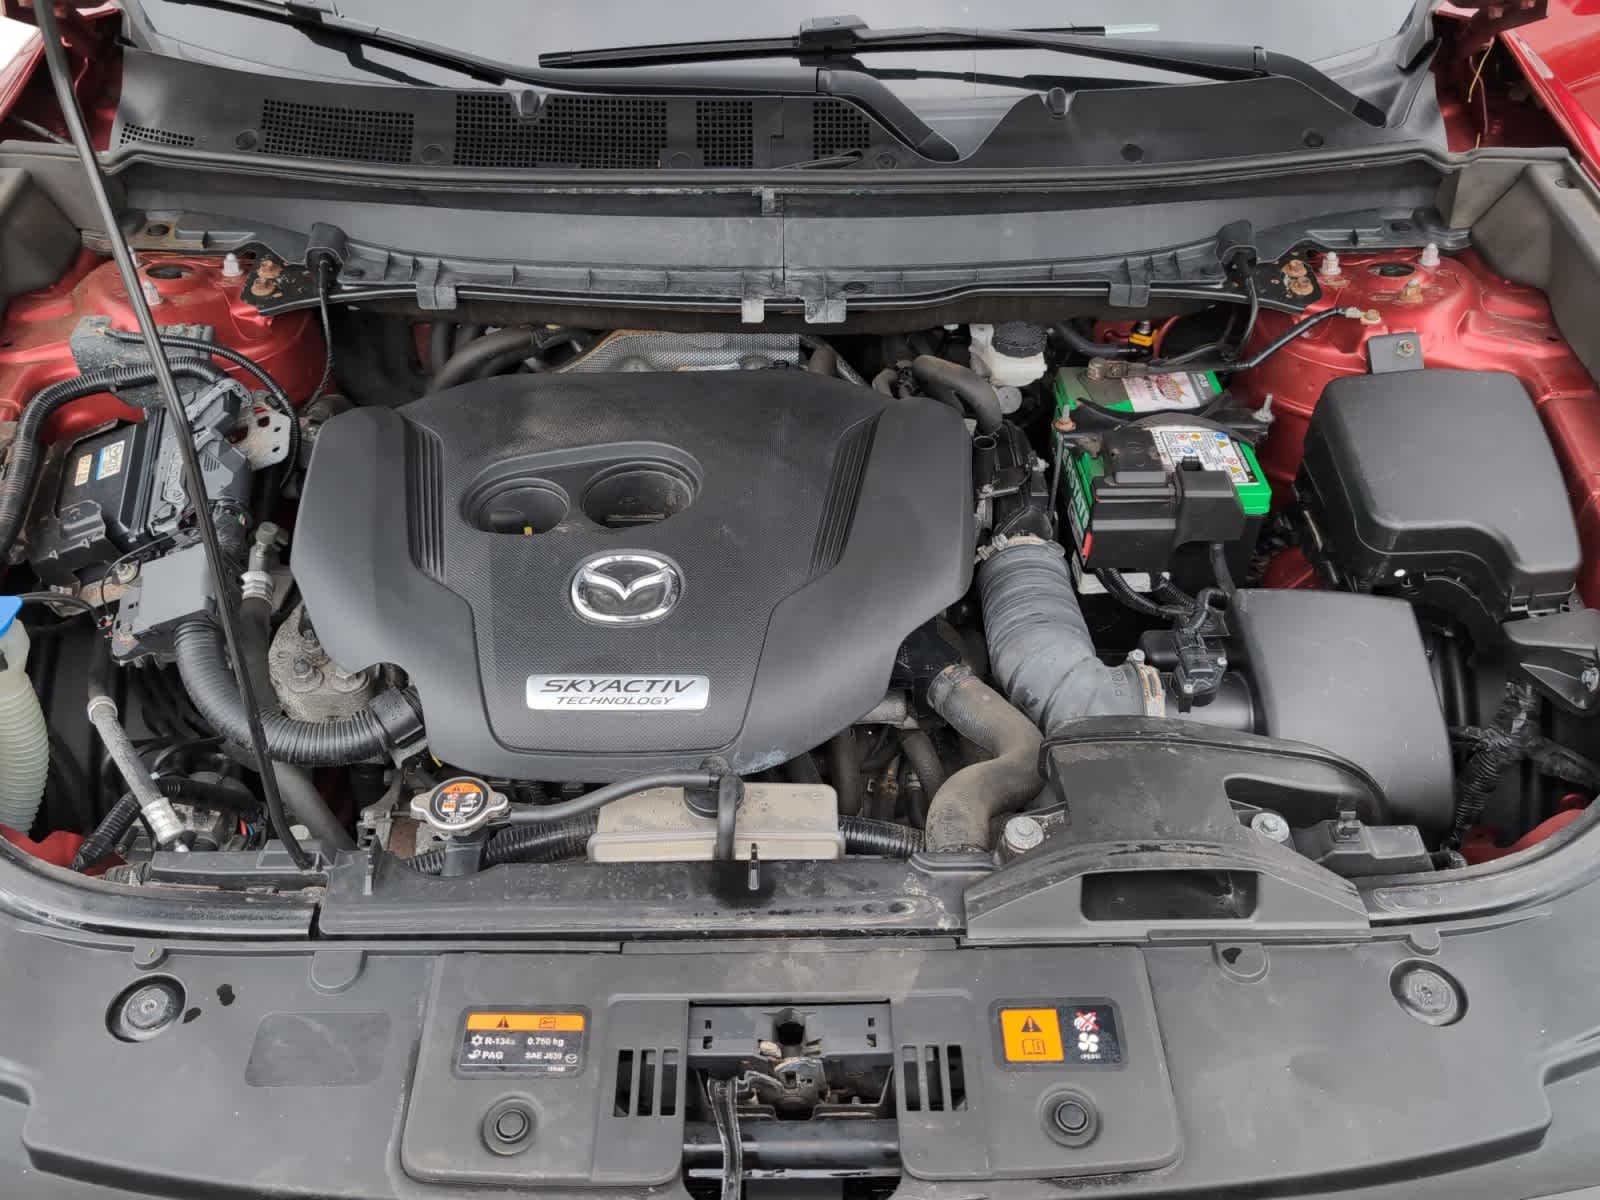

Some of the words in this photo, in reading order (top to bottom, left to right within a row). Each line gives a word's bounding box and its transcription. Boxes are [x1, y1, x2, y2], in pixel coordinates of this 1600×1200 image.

[540, 679, 696, 693] SKYACTIV
[556, 696, 676, 705] TECHNOLOGY
[525, 1051, 542, 1060] SAE
